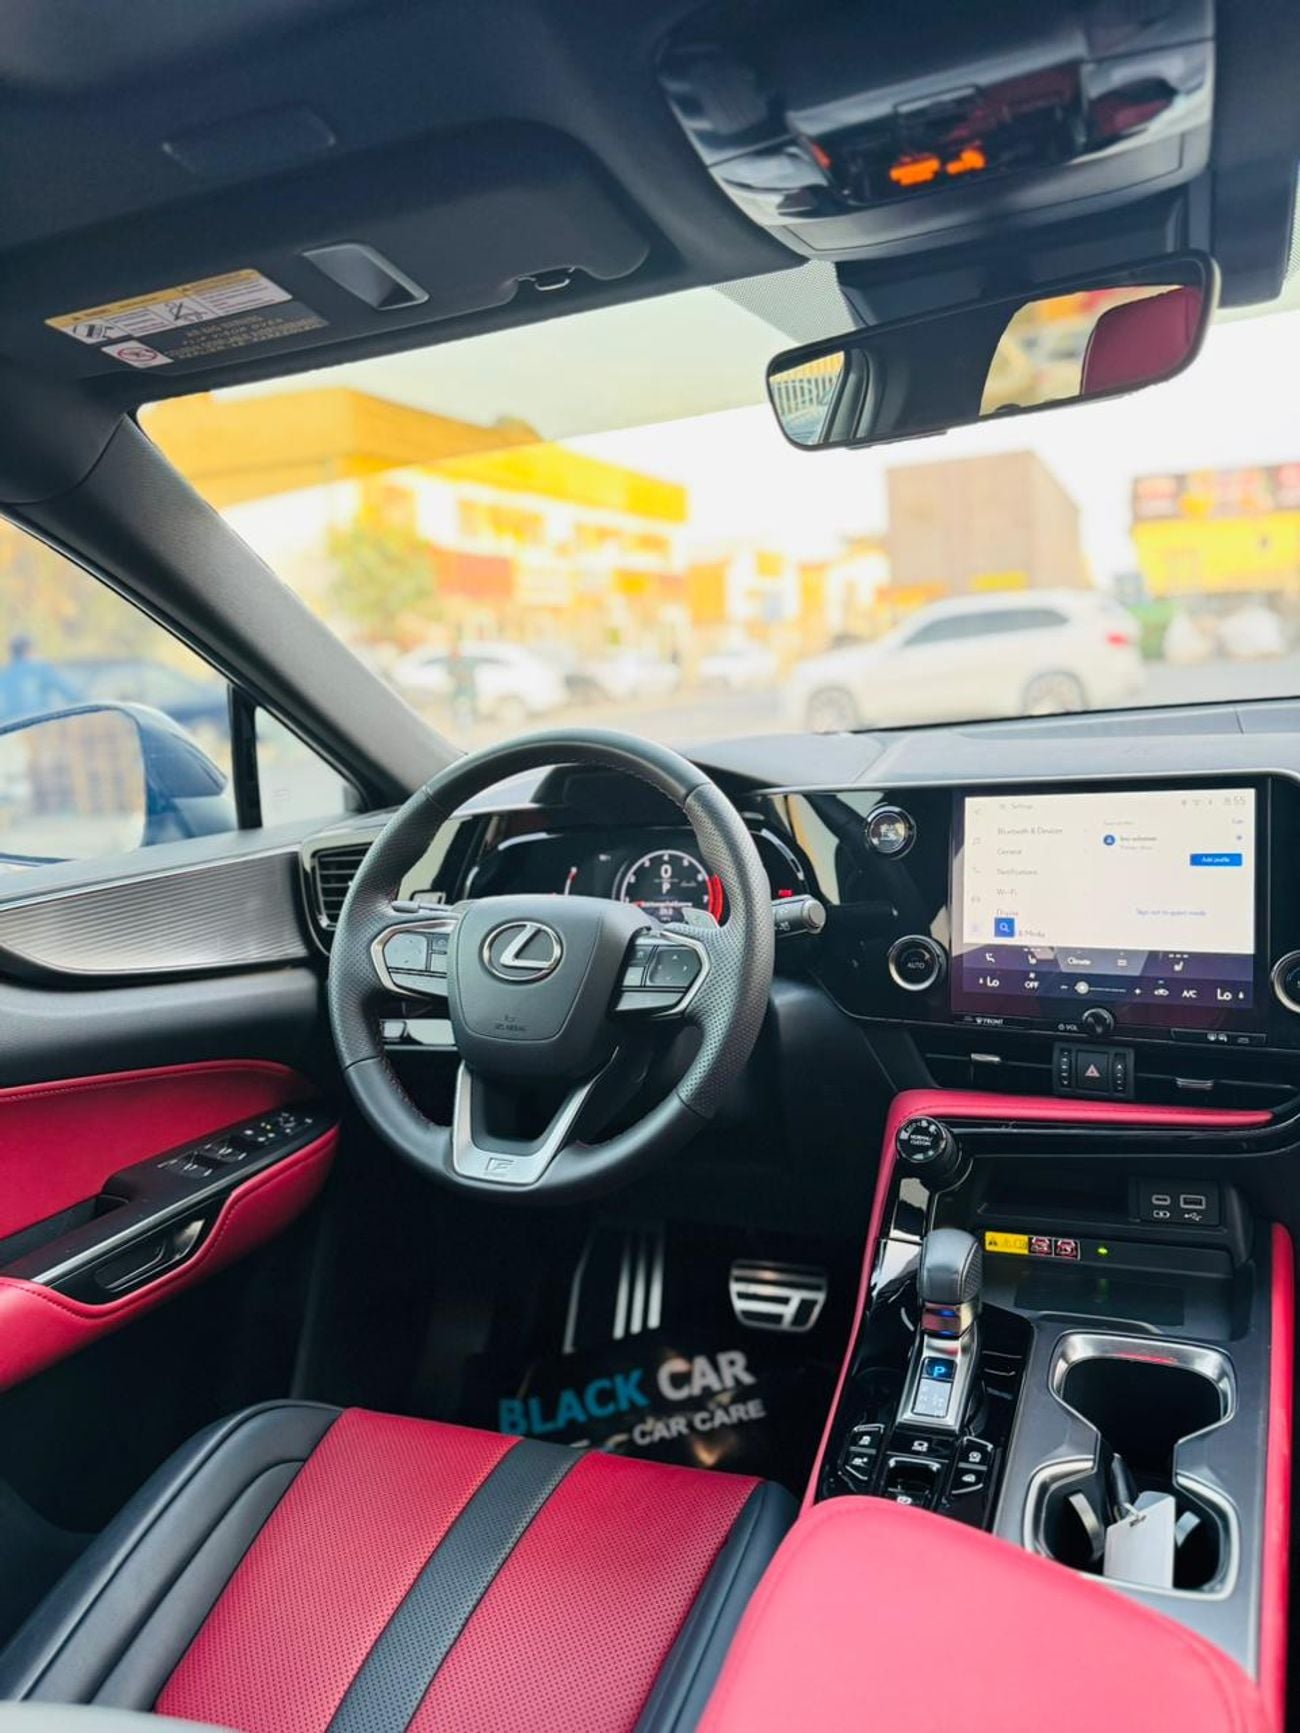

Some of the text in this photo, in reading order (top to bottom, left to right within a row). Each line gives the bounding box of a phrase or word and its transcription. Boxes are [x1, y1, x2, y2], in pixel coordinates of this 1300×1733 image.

[907, 961, 925, 969] AUTO
[986, 976, 1000, 987] Lo
[1217, 988, 1232, 1000] Lo
[934, 1365, 946, 1377] P
[499, 1350, 757, 1435] BLACK CAR
[632, 1398, 767, 1446] CAR CARE
